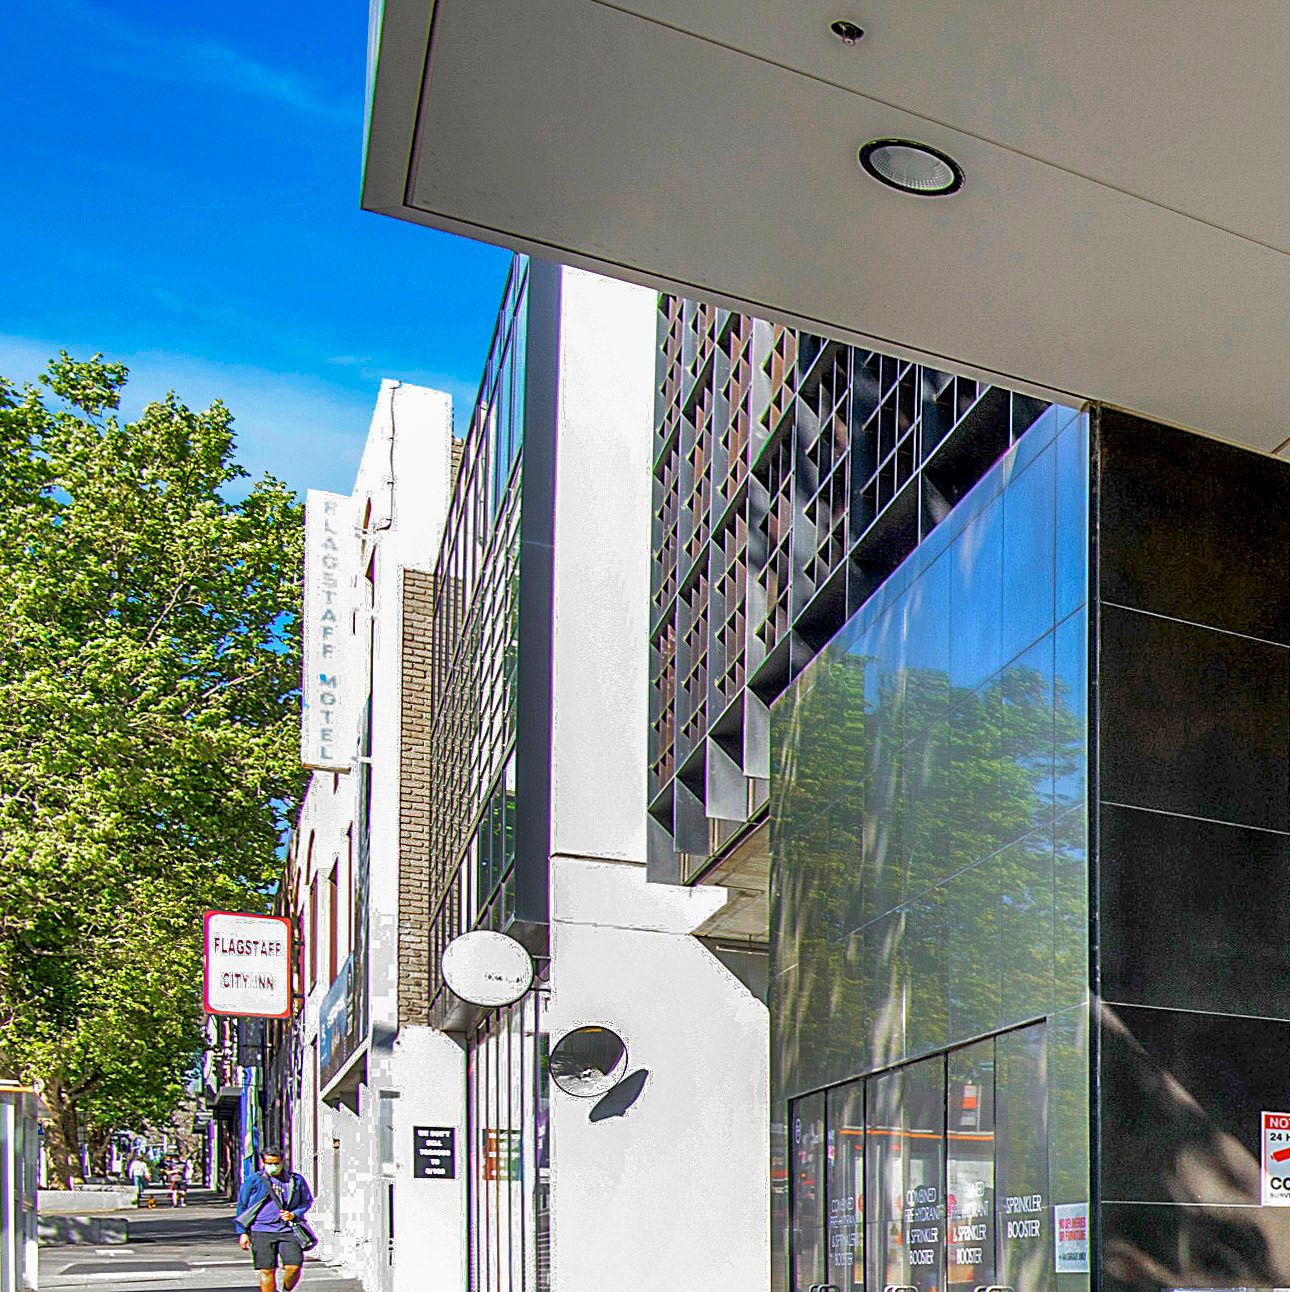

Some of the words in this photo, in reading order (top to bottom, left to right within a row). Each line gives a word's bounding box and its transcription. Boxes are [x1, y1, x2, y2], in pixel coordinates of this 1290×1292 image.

[320, 673, 337, 760] MOTEL
[214, 937, 281, 956] FLAGSTAFF
[222, 972, 248, 989] CITY
[1270, 1133, 1283, 1141] 24
[1006, 1195, 1041, 1214] SPRINKLER
[1008, 1220, 1040, 1238] BOOSTER
[957, 1248, 982, 1264] BOOSTER
